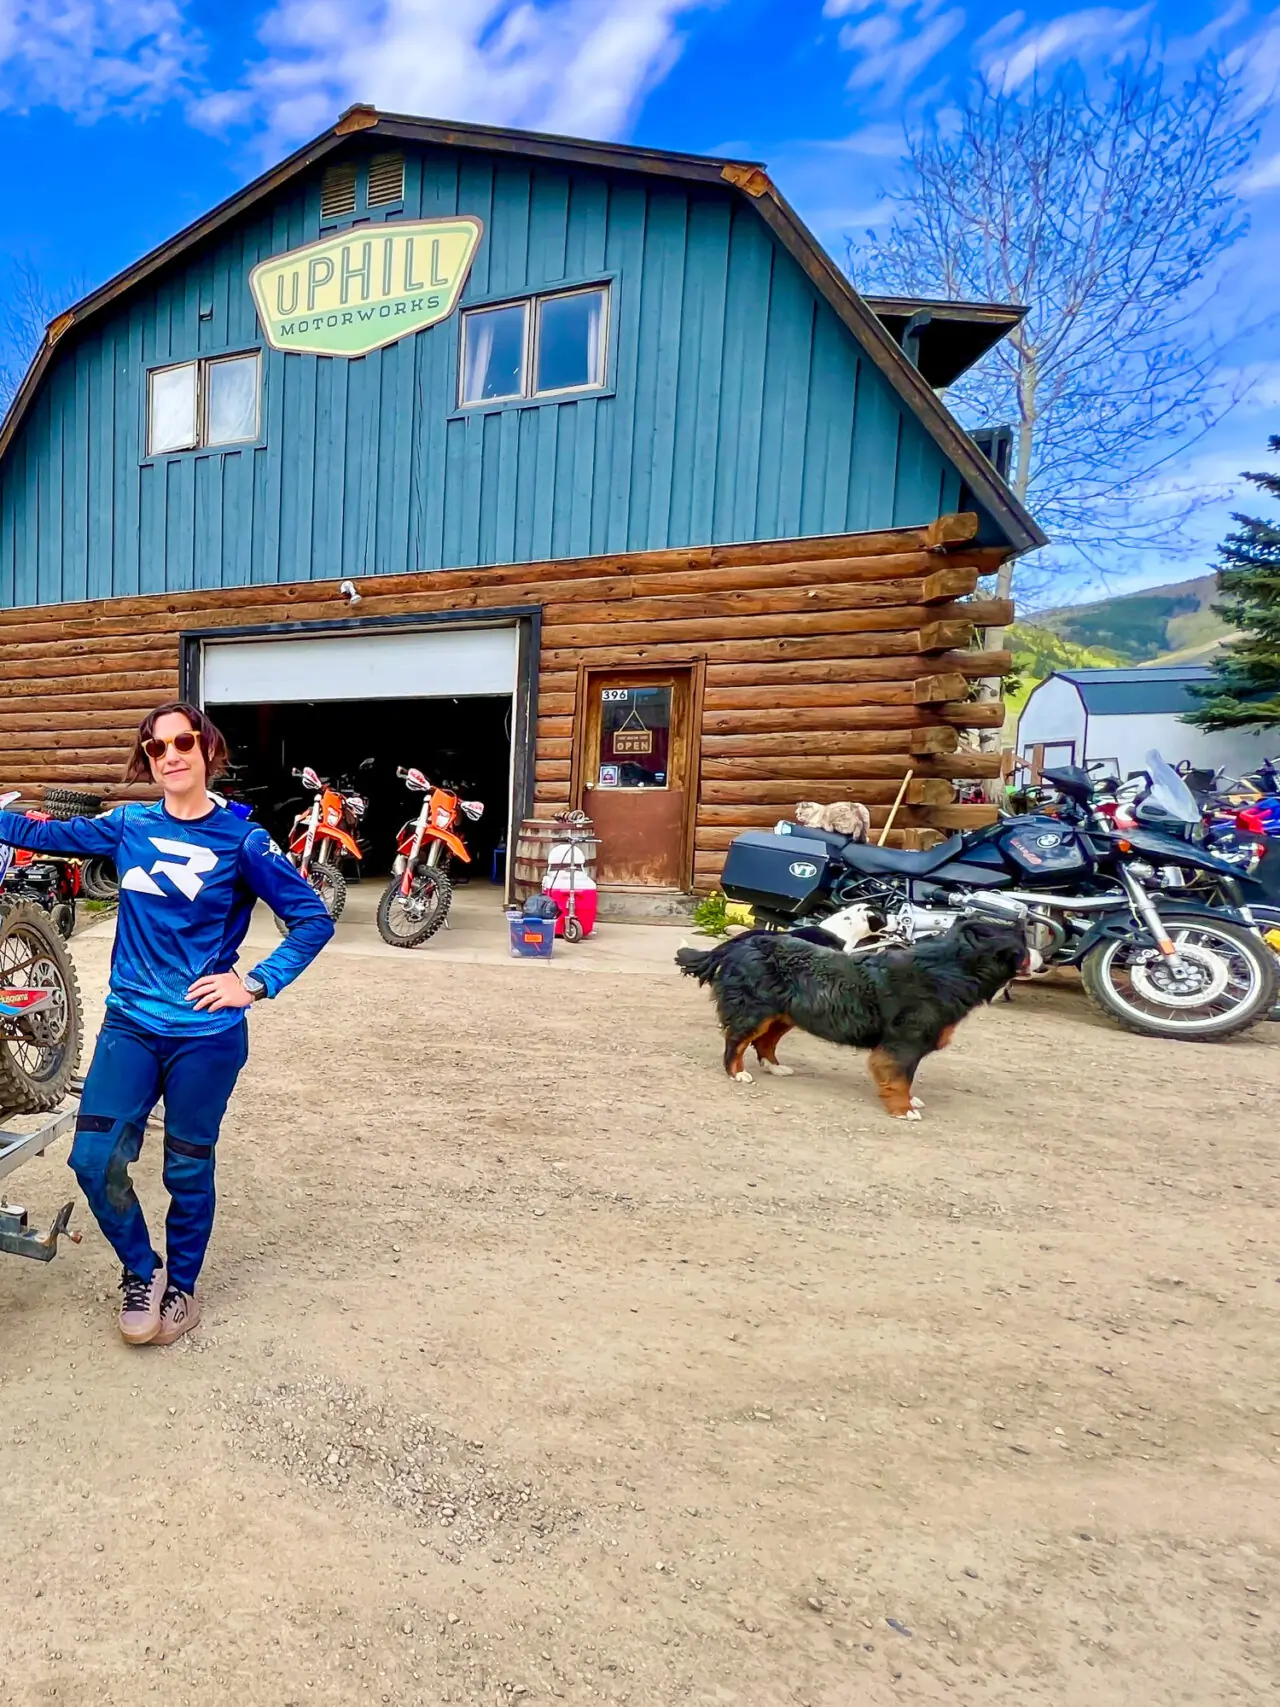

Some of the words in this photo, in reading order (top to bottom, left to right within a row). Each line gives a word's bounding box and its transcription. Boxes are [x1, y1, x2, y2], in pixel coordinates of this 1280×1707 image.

[277, 238, 448, 316] UPHILL
[280, 295, 440, 336] MOTORWORKS
[602, 690, 627, 700] 396
[616, 741, 649, 751] OPEN
